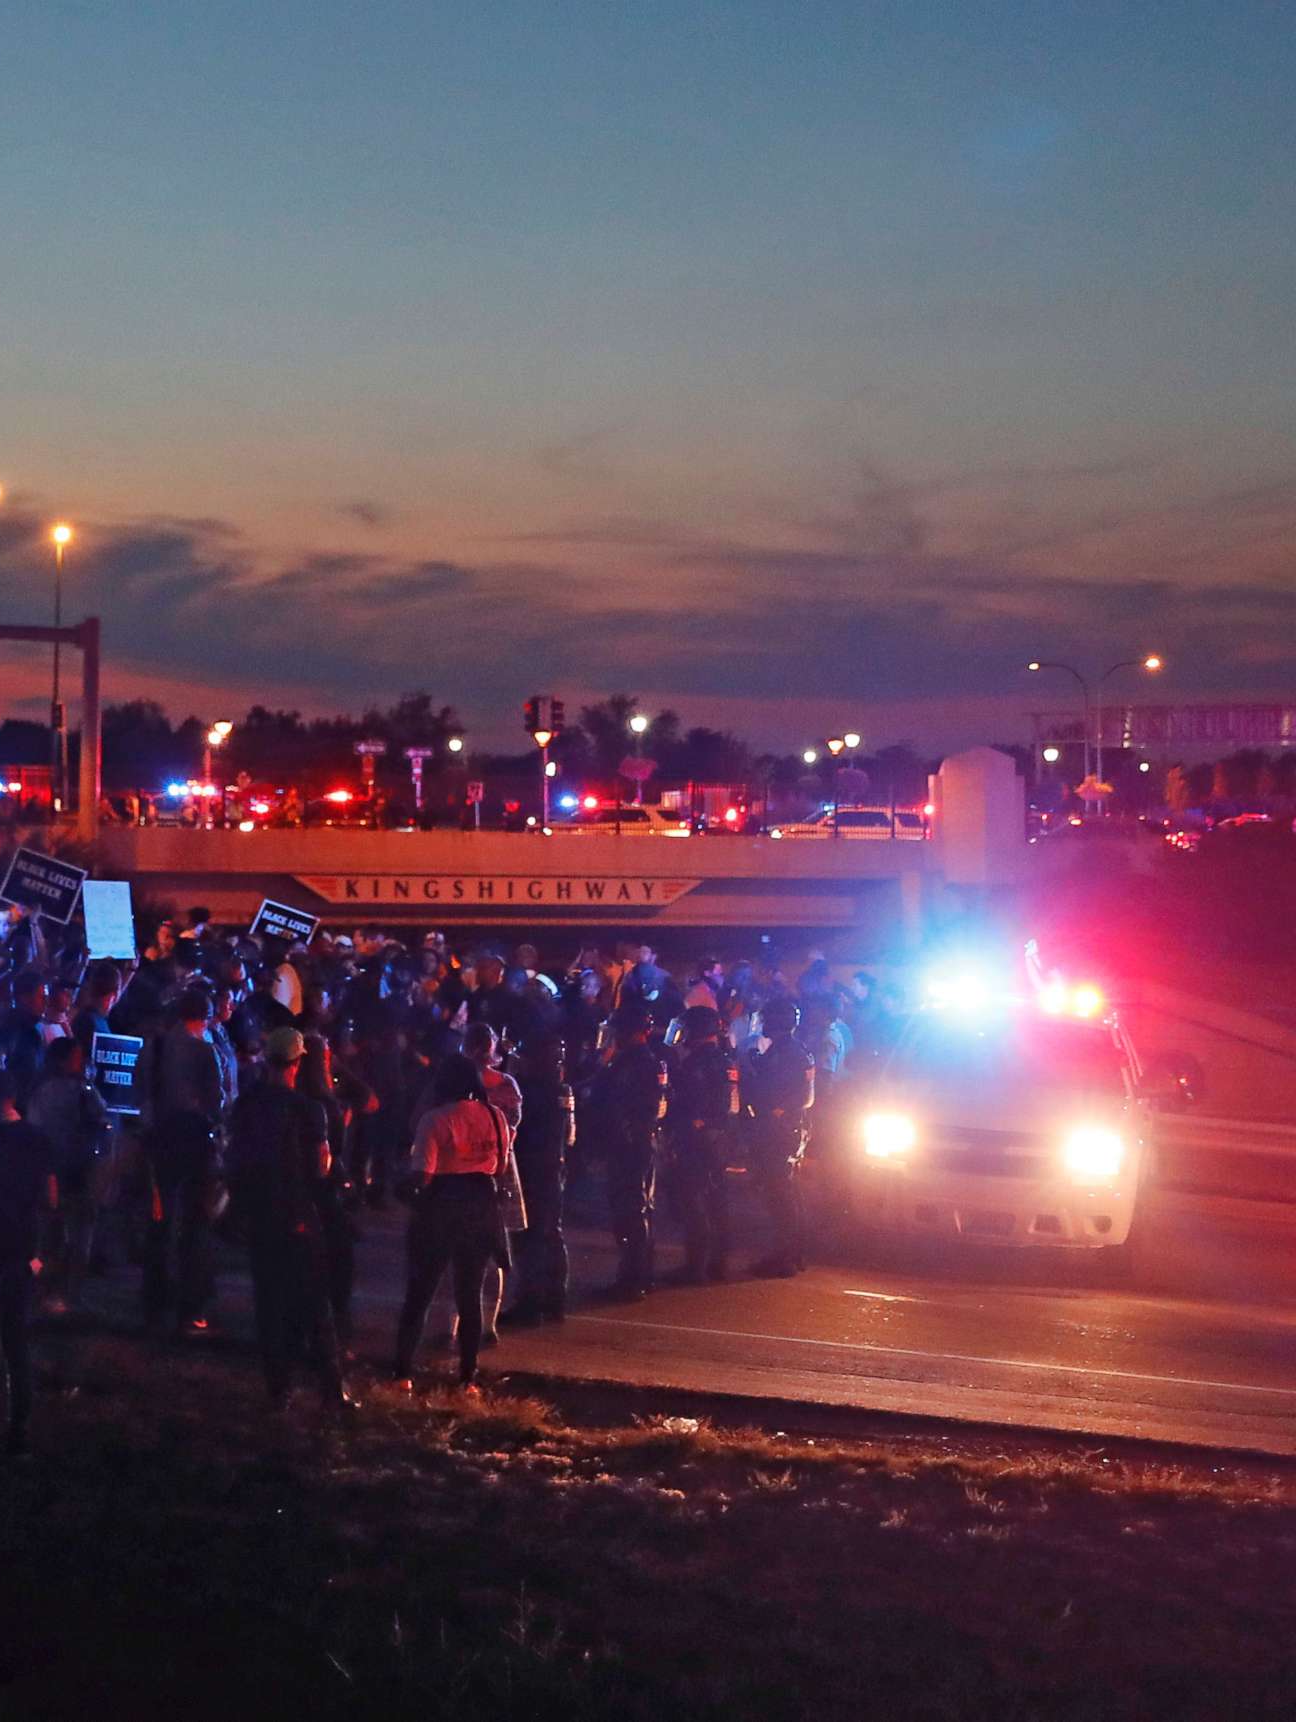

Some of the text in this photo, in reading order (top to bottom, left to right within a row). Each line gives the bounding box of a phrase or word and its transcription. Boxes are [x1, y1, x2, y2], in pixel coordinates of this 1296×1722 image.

[346, 880, 655, 900] KINGSHIGHWAY
[96, 1050, 120, 1065] BLACK
[104, 1070, 133, 1086] MATTER
